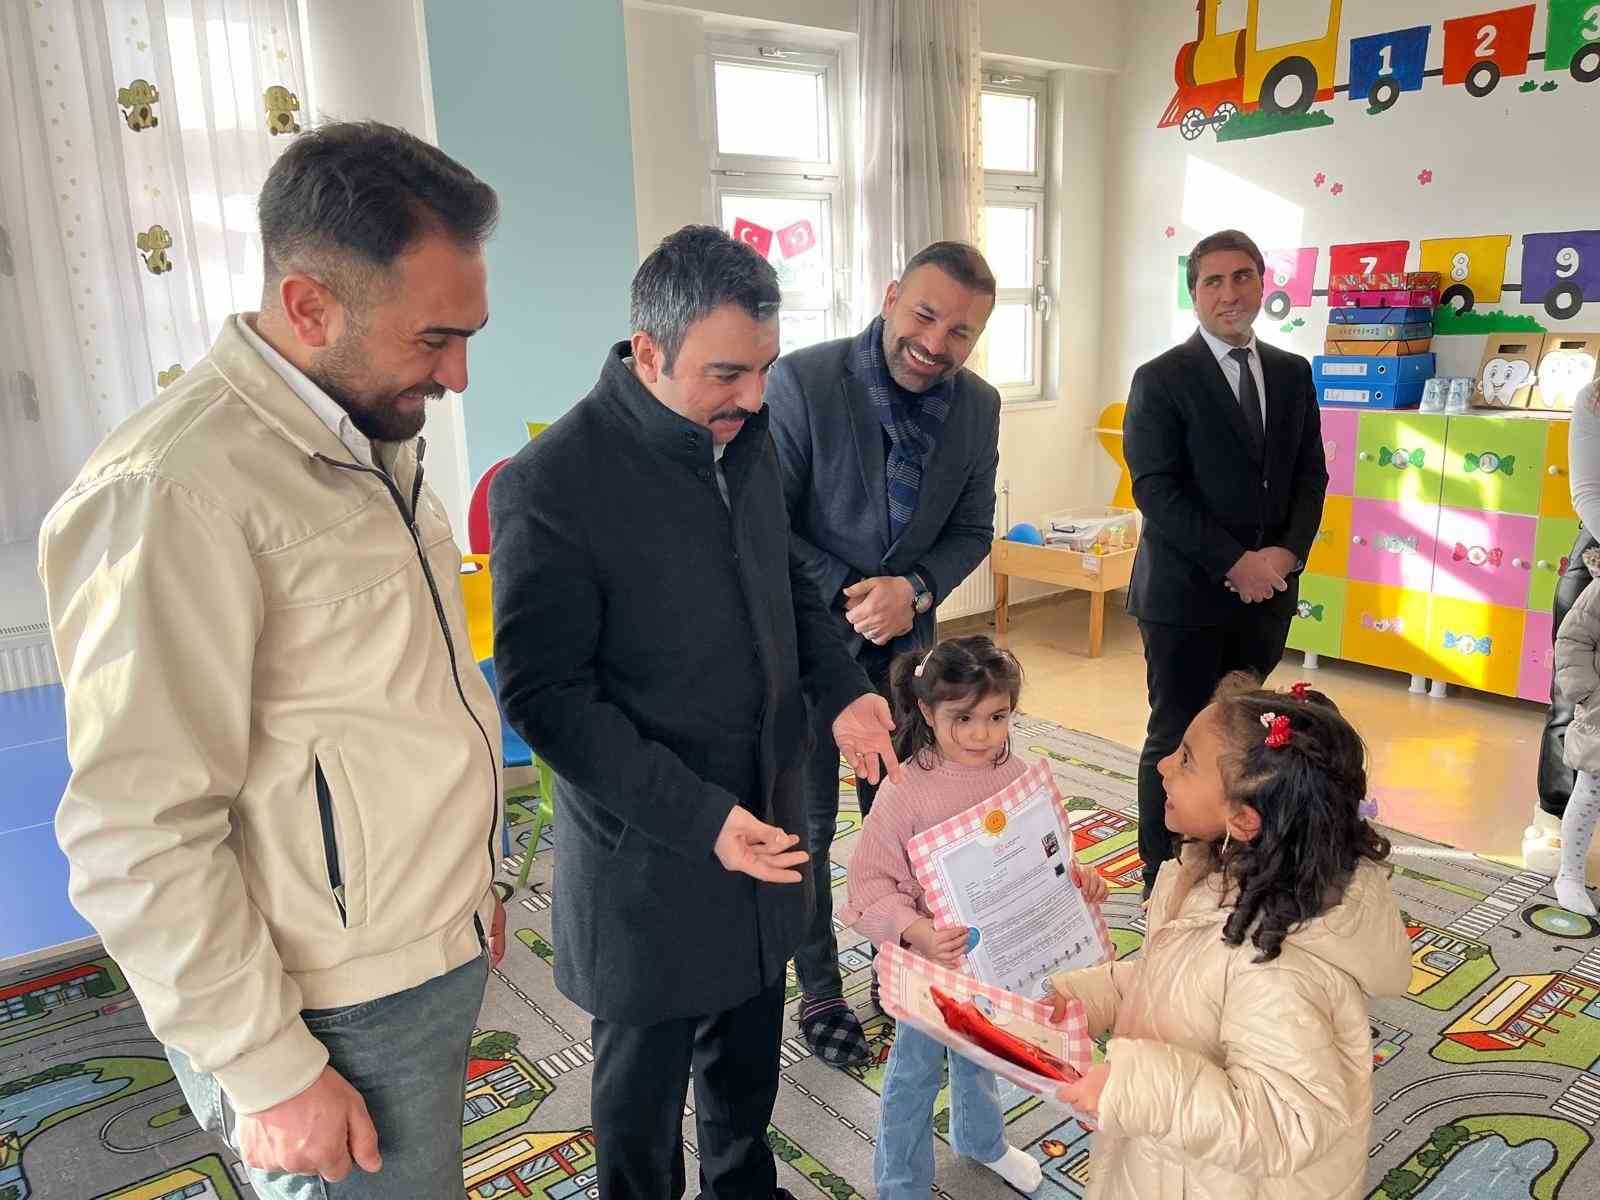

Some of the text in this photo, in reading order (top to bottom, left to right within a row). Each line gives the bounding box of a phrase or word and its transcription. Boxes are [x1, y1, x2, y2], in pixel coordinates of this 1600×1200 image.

[1582, 5, 1600, 41] 3
[1474, 25, 1497, 57] 2
[1378, 45, 1393, 75] 1
[1360, 257, 1378, 274] 7
[1451, 252, 1470, 282] 8
[1555, 247, 1580, 278] 9
